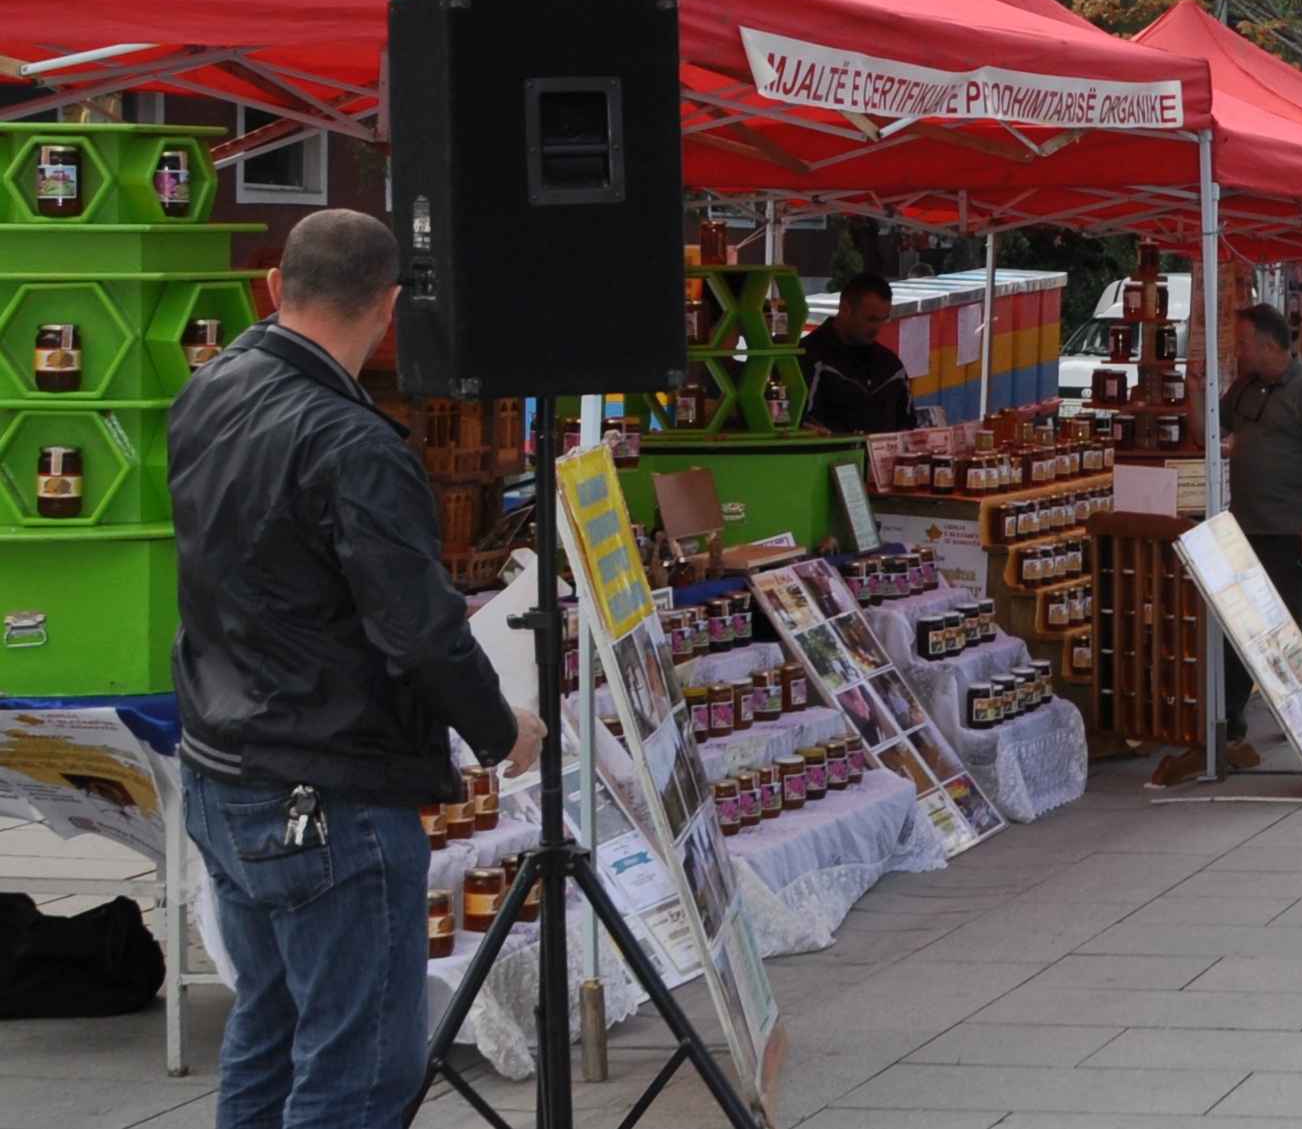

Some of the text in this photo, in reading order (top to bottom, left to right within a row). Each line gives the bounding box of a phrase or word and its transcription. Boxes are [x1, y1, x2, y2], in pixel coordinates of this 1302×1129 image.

[764, 52, 850, 106] MJALTË
[851, 70, 860, 106] E
[1099, 94, 1177, 124] ORGANIKE
